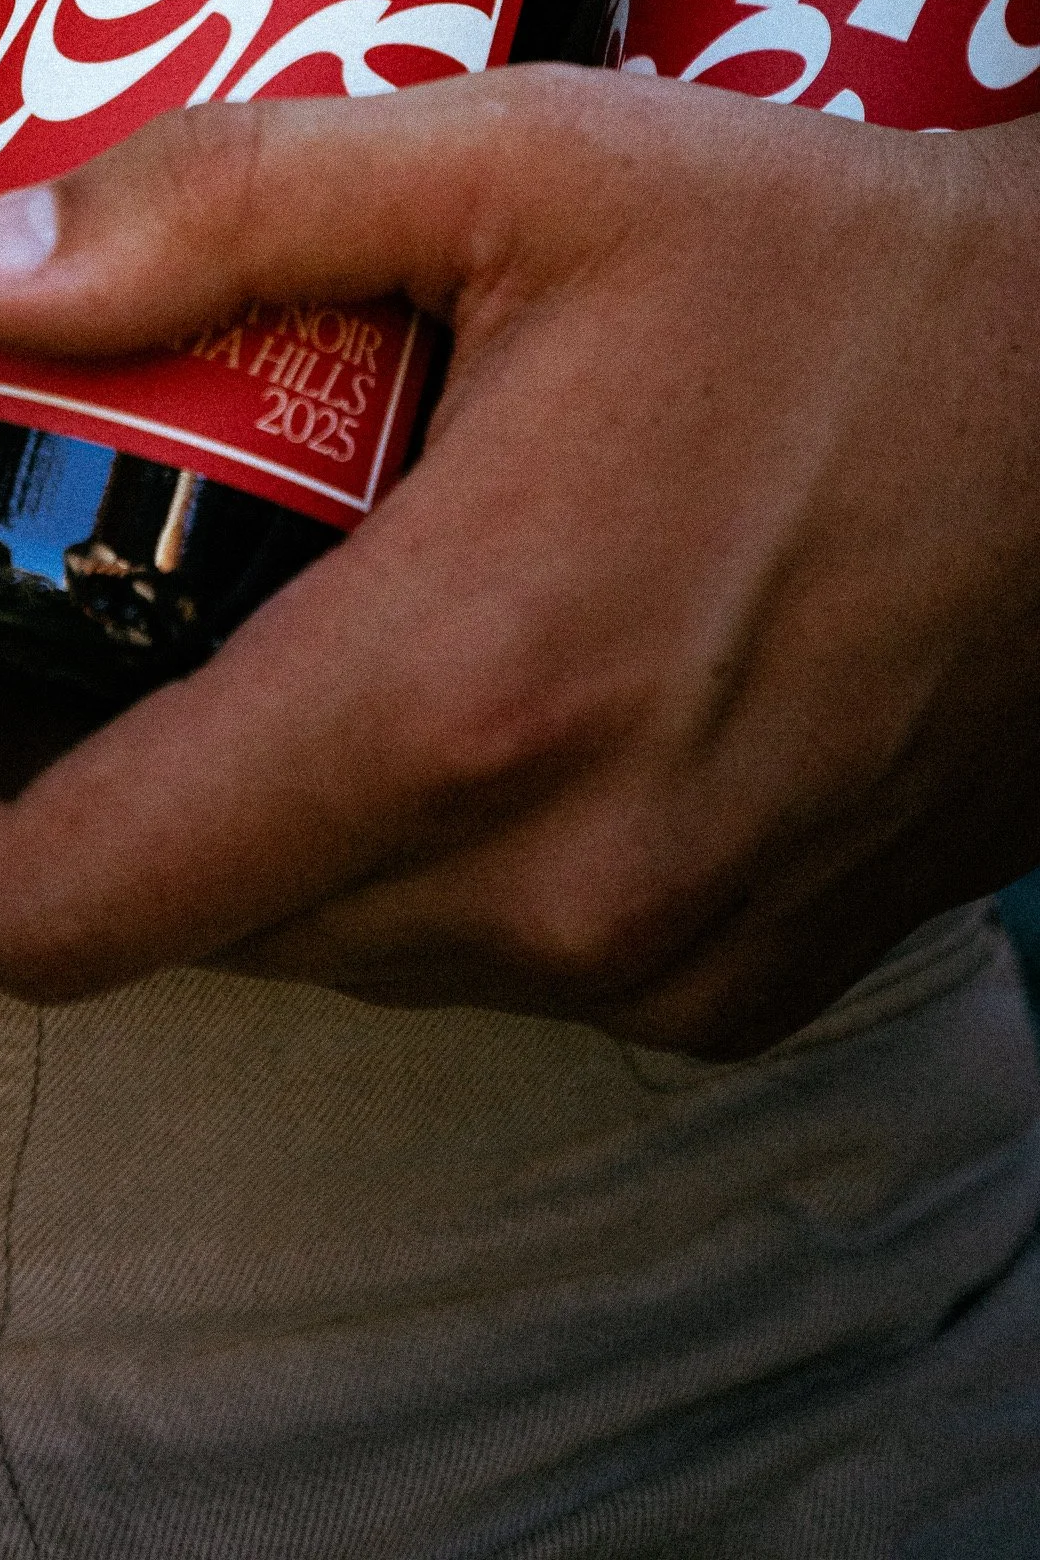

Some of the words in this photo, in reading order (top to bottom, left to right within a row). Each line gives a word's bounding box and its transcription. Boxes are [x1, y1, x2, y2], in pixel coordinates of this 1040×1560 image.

[247, 335, 376, 416] HILLS
[275, 303, 383, 374] NOIR
[255, 386, 360, 463] 2025
